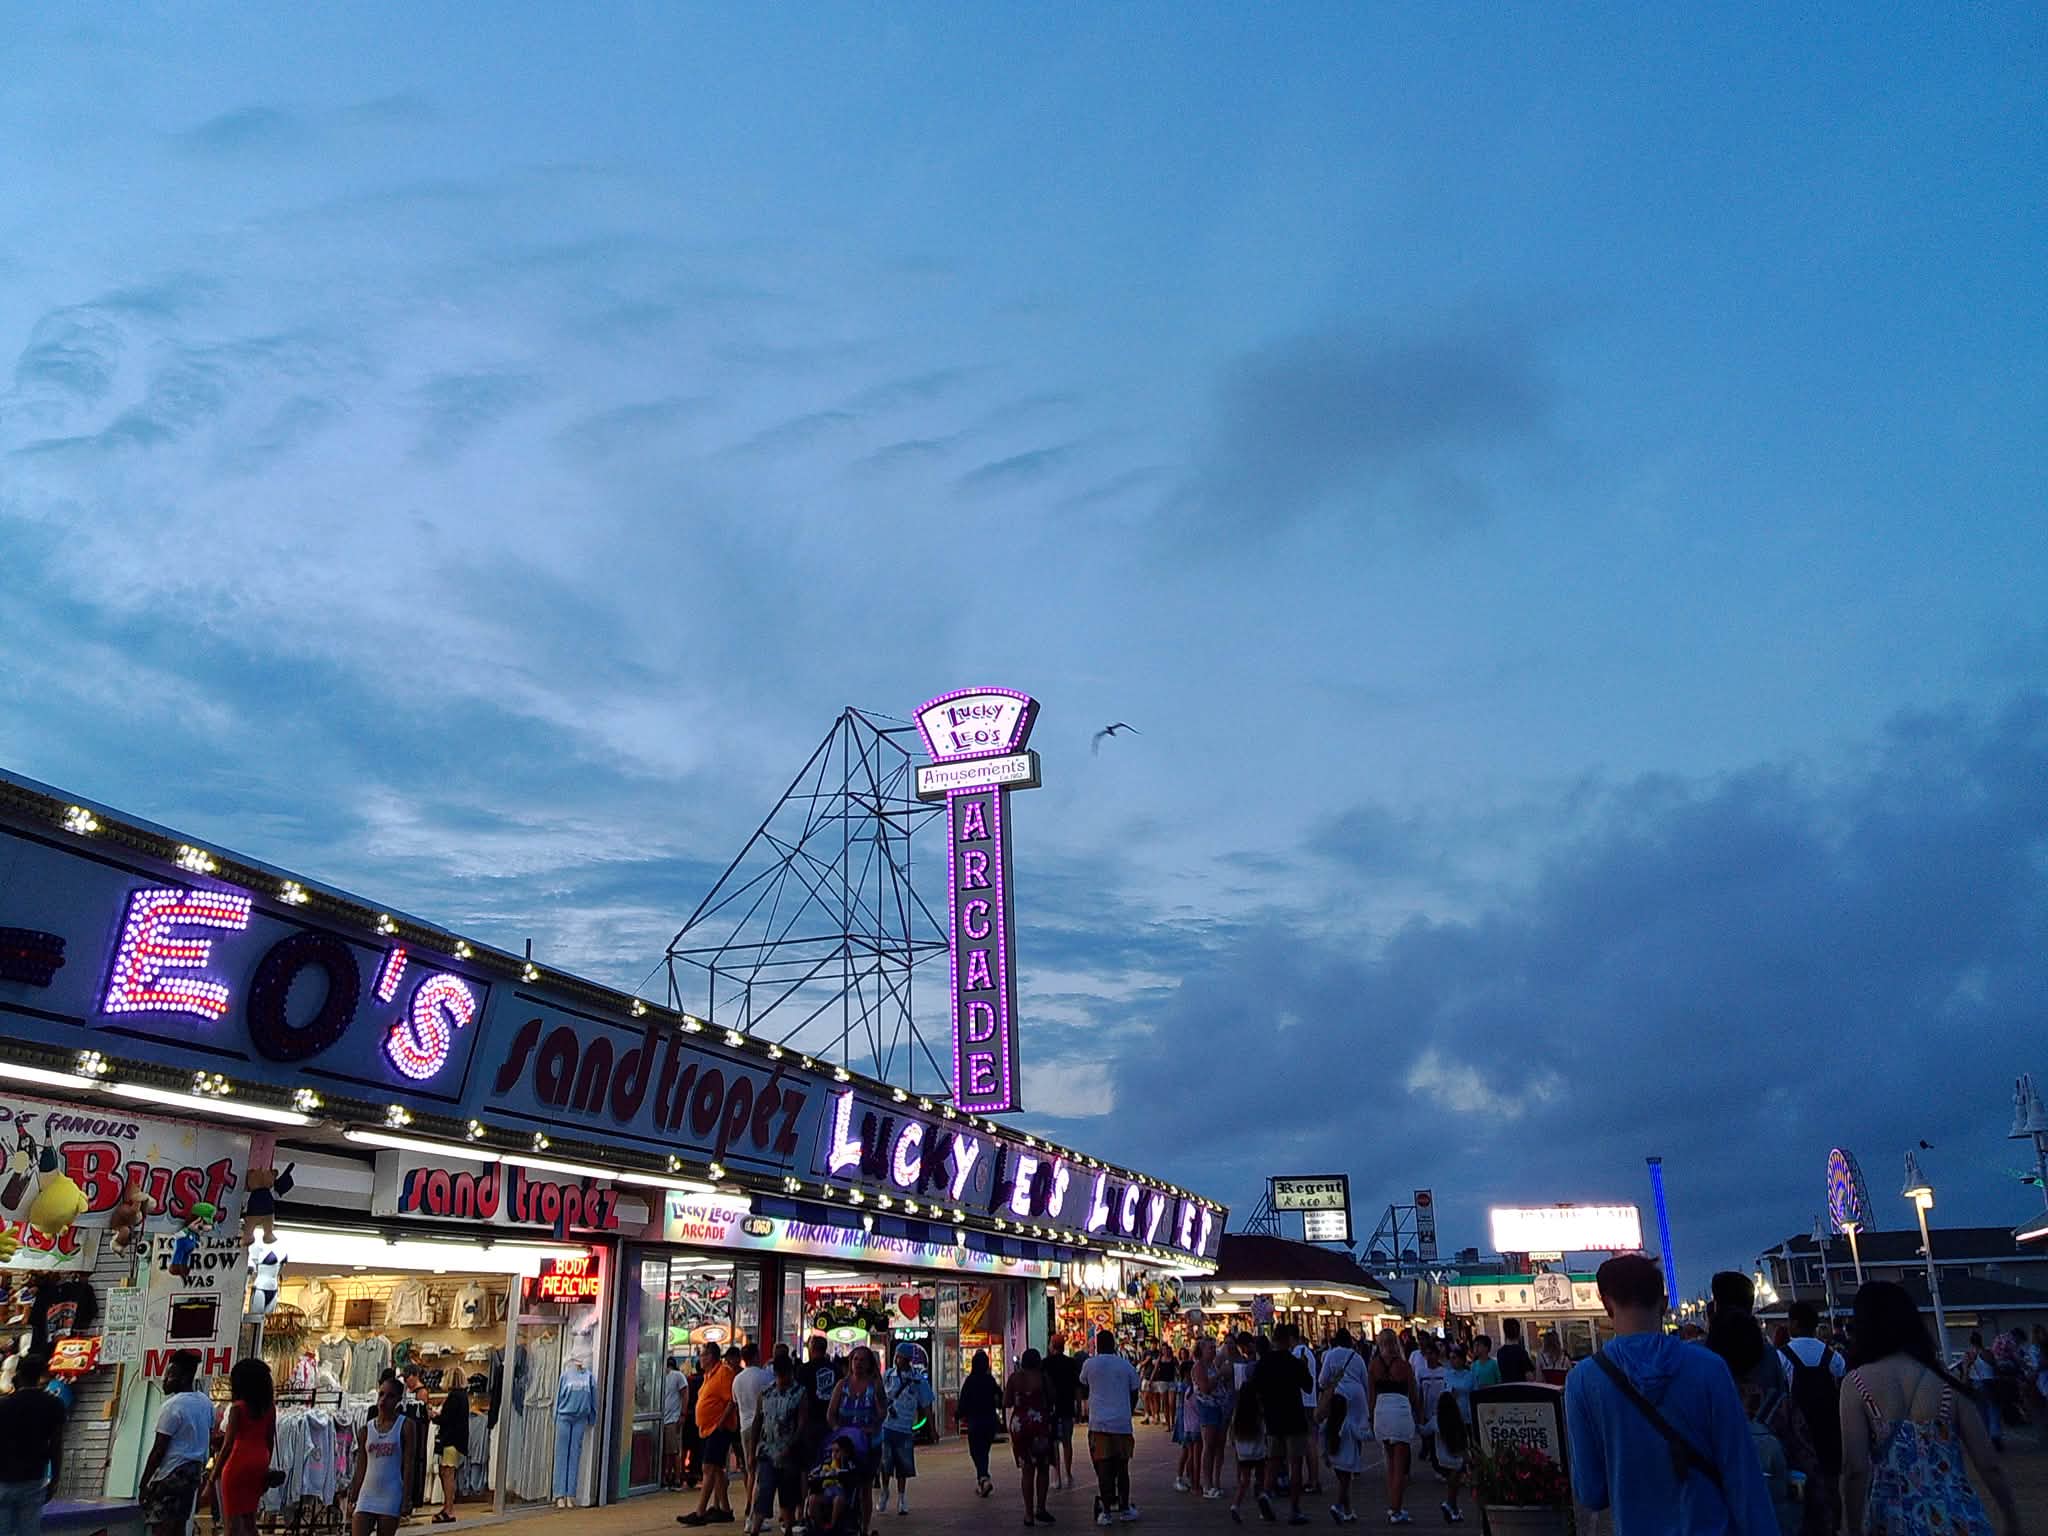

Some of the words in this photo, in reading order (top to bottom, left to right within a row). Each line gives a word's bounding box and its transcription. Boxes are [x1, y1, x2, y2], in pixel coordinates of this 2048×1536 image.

[924, 760, 1026, 785] Amusements
[959, 801, 999, 1096] ARCADE
[495, 1018, 659, 1122] sand
[46, 1112, 139, 1140] FAMOUS
[826, 1089, 980, 1200] LUCKY
[402, 1161, 500, 1218] sand
[1276, 1181, 1342, 1195] Regent
[207, 1236, 242, 1248] LAST
[681, 1223, 725, 1240] ARCADE
[785, 1219, 840, 1244] MAKING
[841, 1231, 904, 1251] MEMORIES
[906, 1239, 926, 1255] FOR
[928, 1242, 953, 1258] OVER
[159, 1252, 239, 1270] TROW
[556, 1258, 590, 1275] BODY
[183, 1275, 215, 1287] WAS
[540, 1276, 600, 1297] PIERCING
[144, 1347, 234, 1377] MH
[1491, 1426, 1547, 1440] SEASIDE
